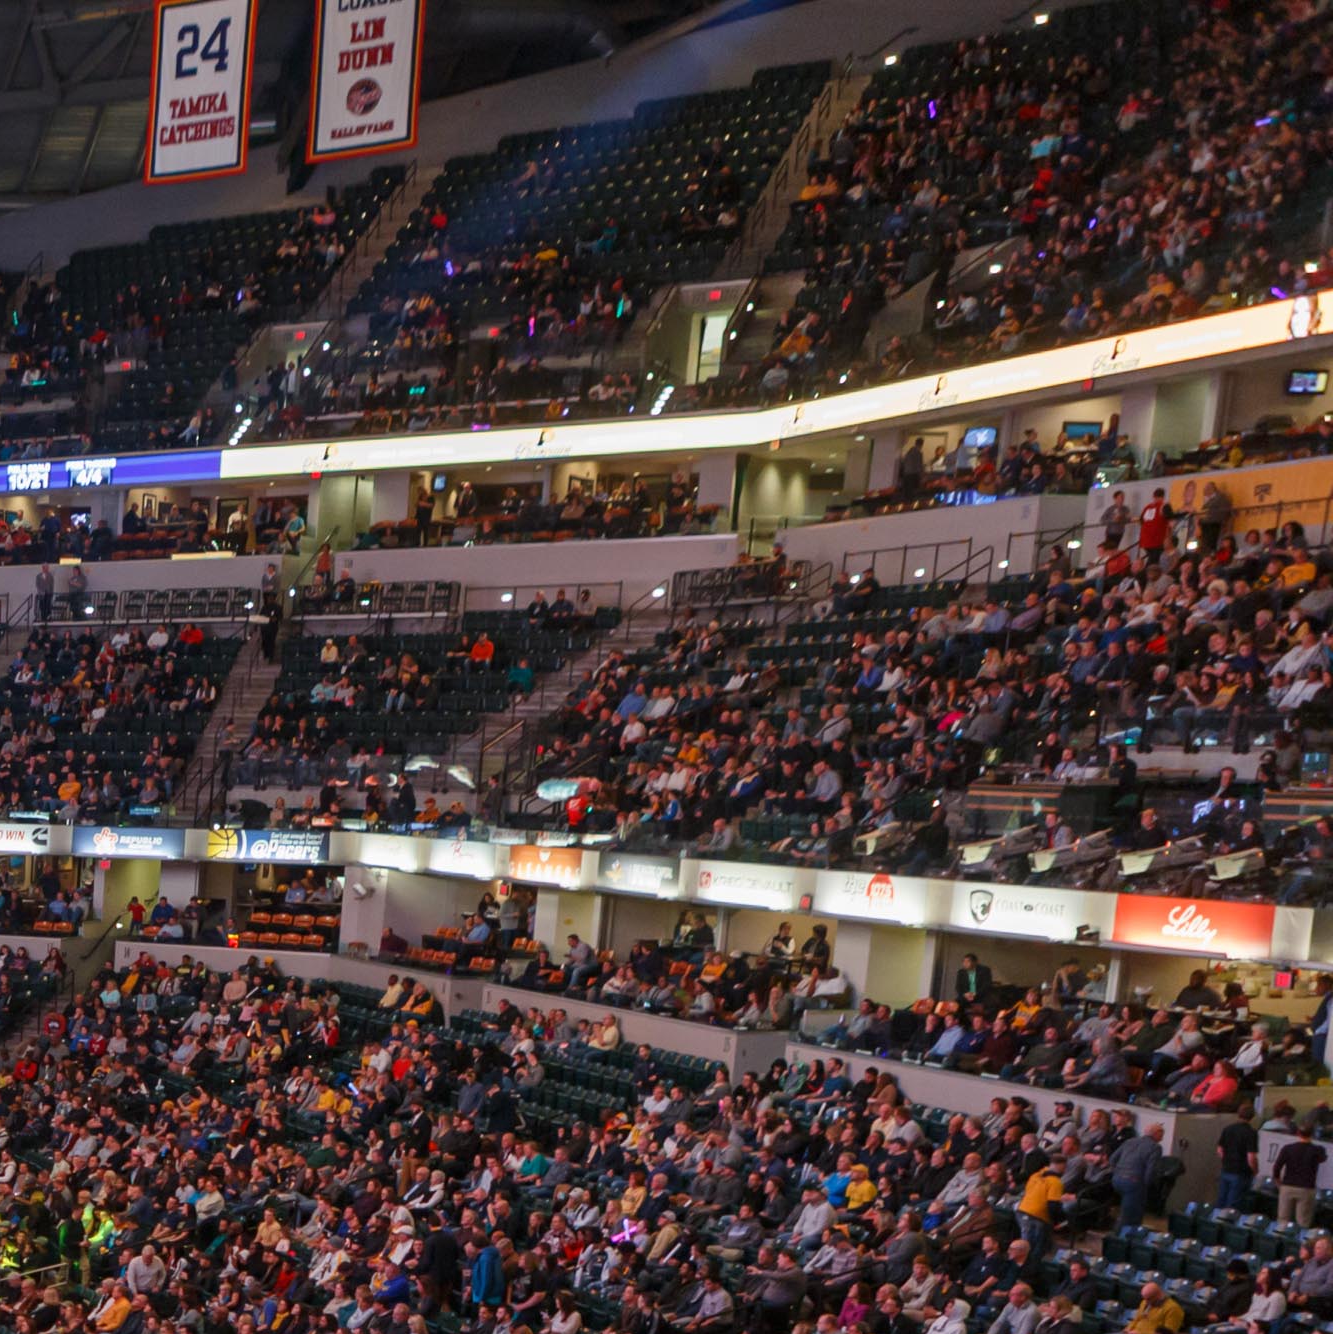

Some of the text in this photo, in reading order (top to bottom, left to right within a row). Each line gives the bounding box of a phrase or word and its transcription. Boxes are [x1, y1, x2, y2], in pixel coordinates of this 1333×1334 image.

[350, 17, 386, 44] LIN
[174, 17, 231, 79] 24
[338, 42, 395, 73] DUNN
[169, 92, 229, 119] TAMIKA
[159, 116, 235, 146] CATCHINGS
[8, 473, 49, 491] 10/21
[75, 469, 103, 486] 4/4
[6, 830, 26, 841] WIN
[119, 835, 163, 845] REPUBLIC
[251, 840, 321, 860] @Pacers
[1162, 904, 1219, 946] Lilly
